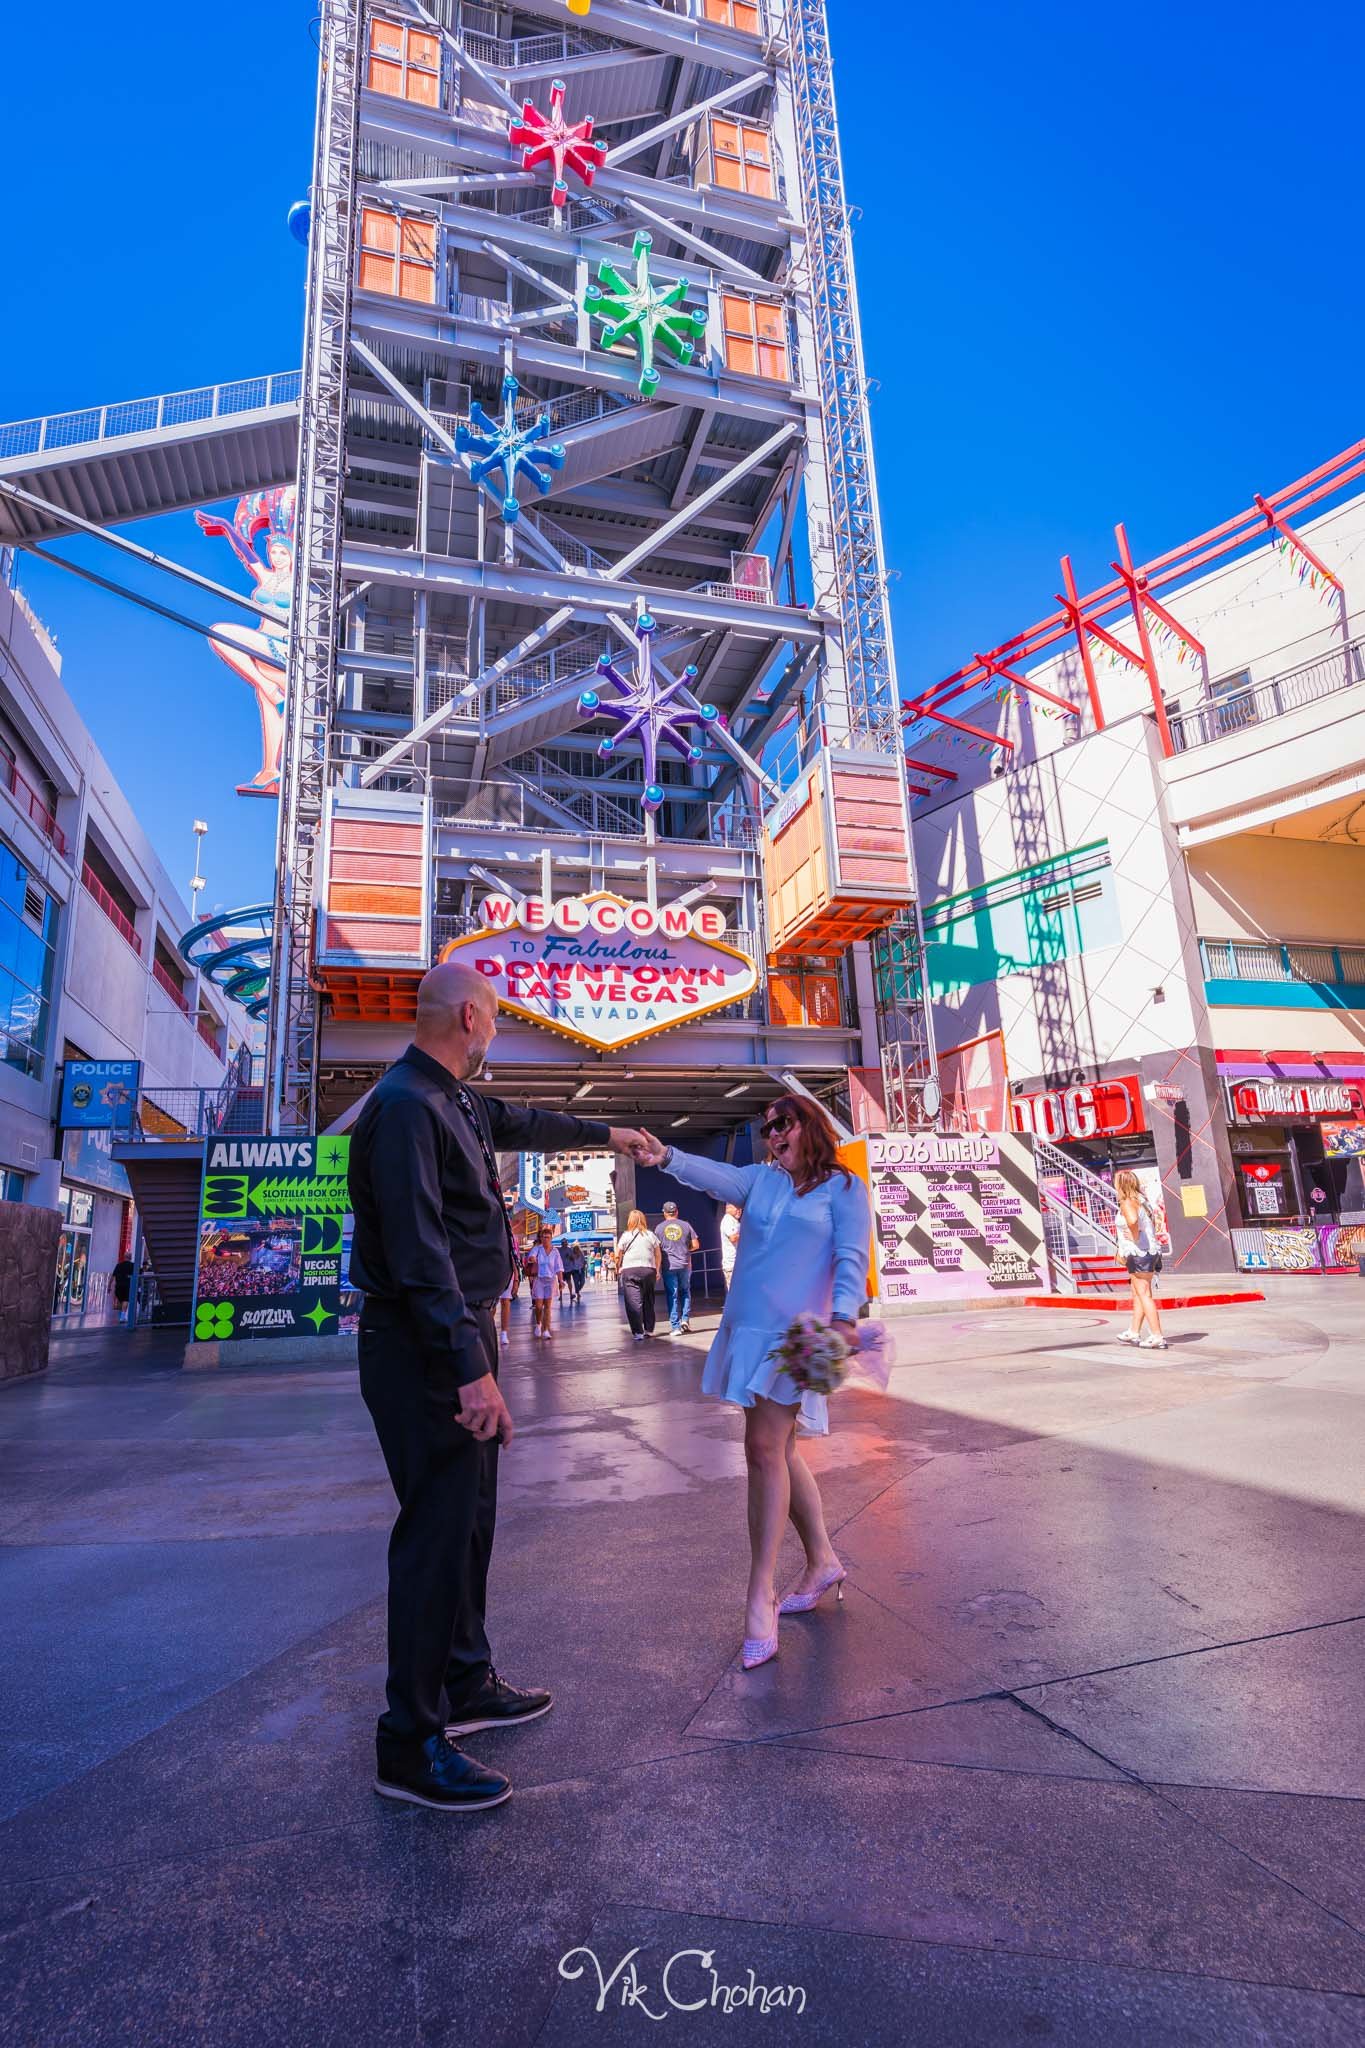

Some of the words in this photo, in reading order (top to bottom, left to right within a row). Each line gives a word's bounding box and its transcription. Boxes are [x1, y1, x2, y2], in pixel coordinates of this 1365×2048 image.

[484, 900, 719, 934] WELCOME
[510, 941, 535, 954] TO
[542, 935, 676, 961] Fabulous
[475, 959, 725, 987] DOWNTOWN
[507, 980, 571, 1000] LAS
[584, 983, 700, 1004] VEGAS
[554, 1005, 657, 1021] NEVADA
[71, 1063, 132, 1076] POLICE
[1011, 1086, 1098, 1142] DOG
[210, 1142, 312, 1168] ALWAYS
[874, 1142, 930, 1164] 2026
[935, 1139, 994, 1163] LINEUP
[263, 1190, 305, 1198] SLOTZILLA
[308, 1189, 326, 1197] BOX
[879, 1185, 888, 1193] LEE
[930, 1211, 944, 1219] WITH
[932, 1230, 955, 1238] MAYDAY
[884, 1241, 897, 1249] FUEL
[934, 1249, 953, 1257] STORY
[994, 1254, 1016, 1263] ROCKS
[886, 1260, 906, 1268] FINGER
[908, 1259, 928, 1267] ELEVEN
[989, 1262, 1030, 1274] SUMMER
[303, 1276, 338, 1286] ZIPLINE
[986, 1273, 1015, 1282] CONCERT
[1016, 1272, 1037, 1281] SERIES
[240, 1309, 295, 1326] SLOTZILLA
